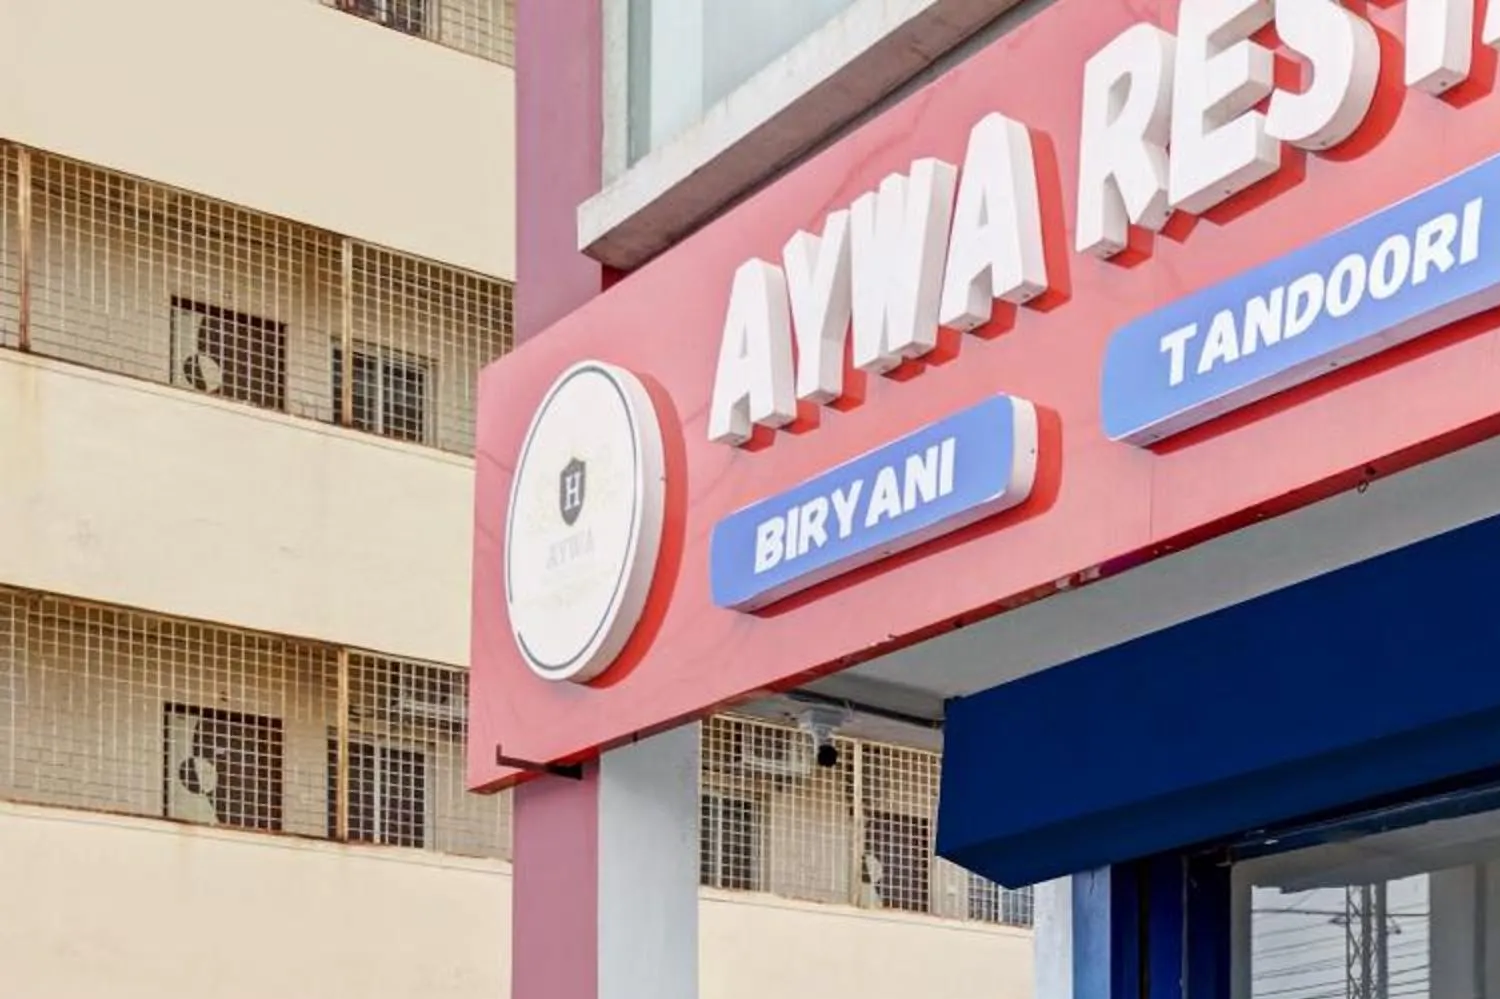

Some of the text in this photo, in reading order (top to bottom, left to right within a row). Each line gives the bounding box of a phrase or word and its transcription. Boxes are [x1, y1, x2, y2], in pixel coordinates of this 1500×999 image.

[707, 111, 1048, 443] AYWA
[1159, 197, 1484, 386] TANDOORI
[564, 472, 583, 511] H
[753, 437, 956, 573] BIRYANI
